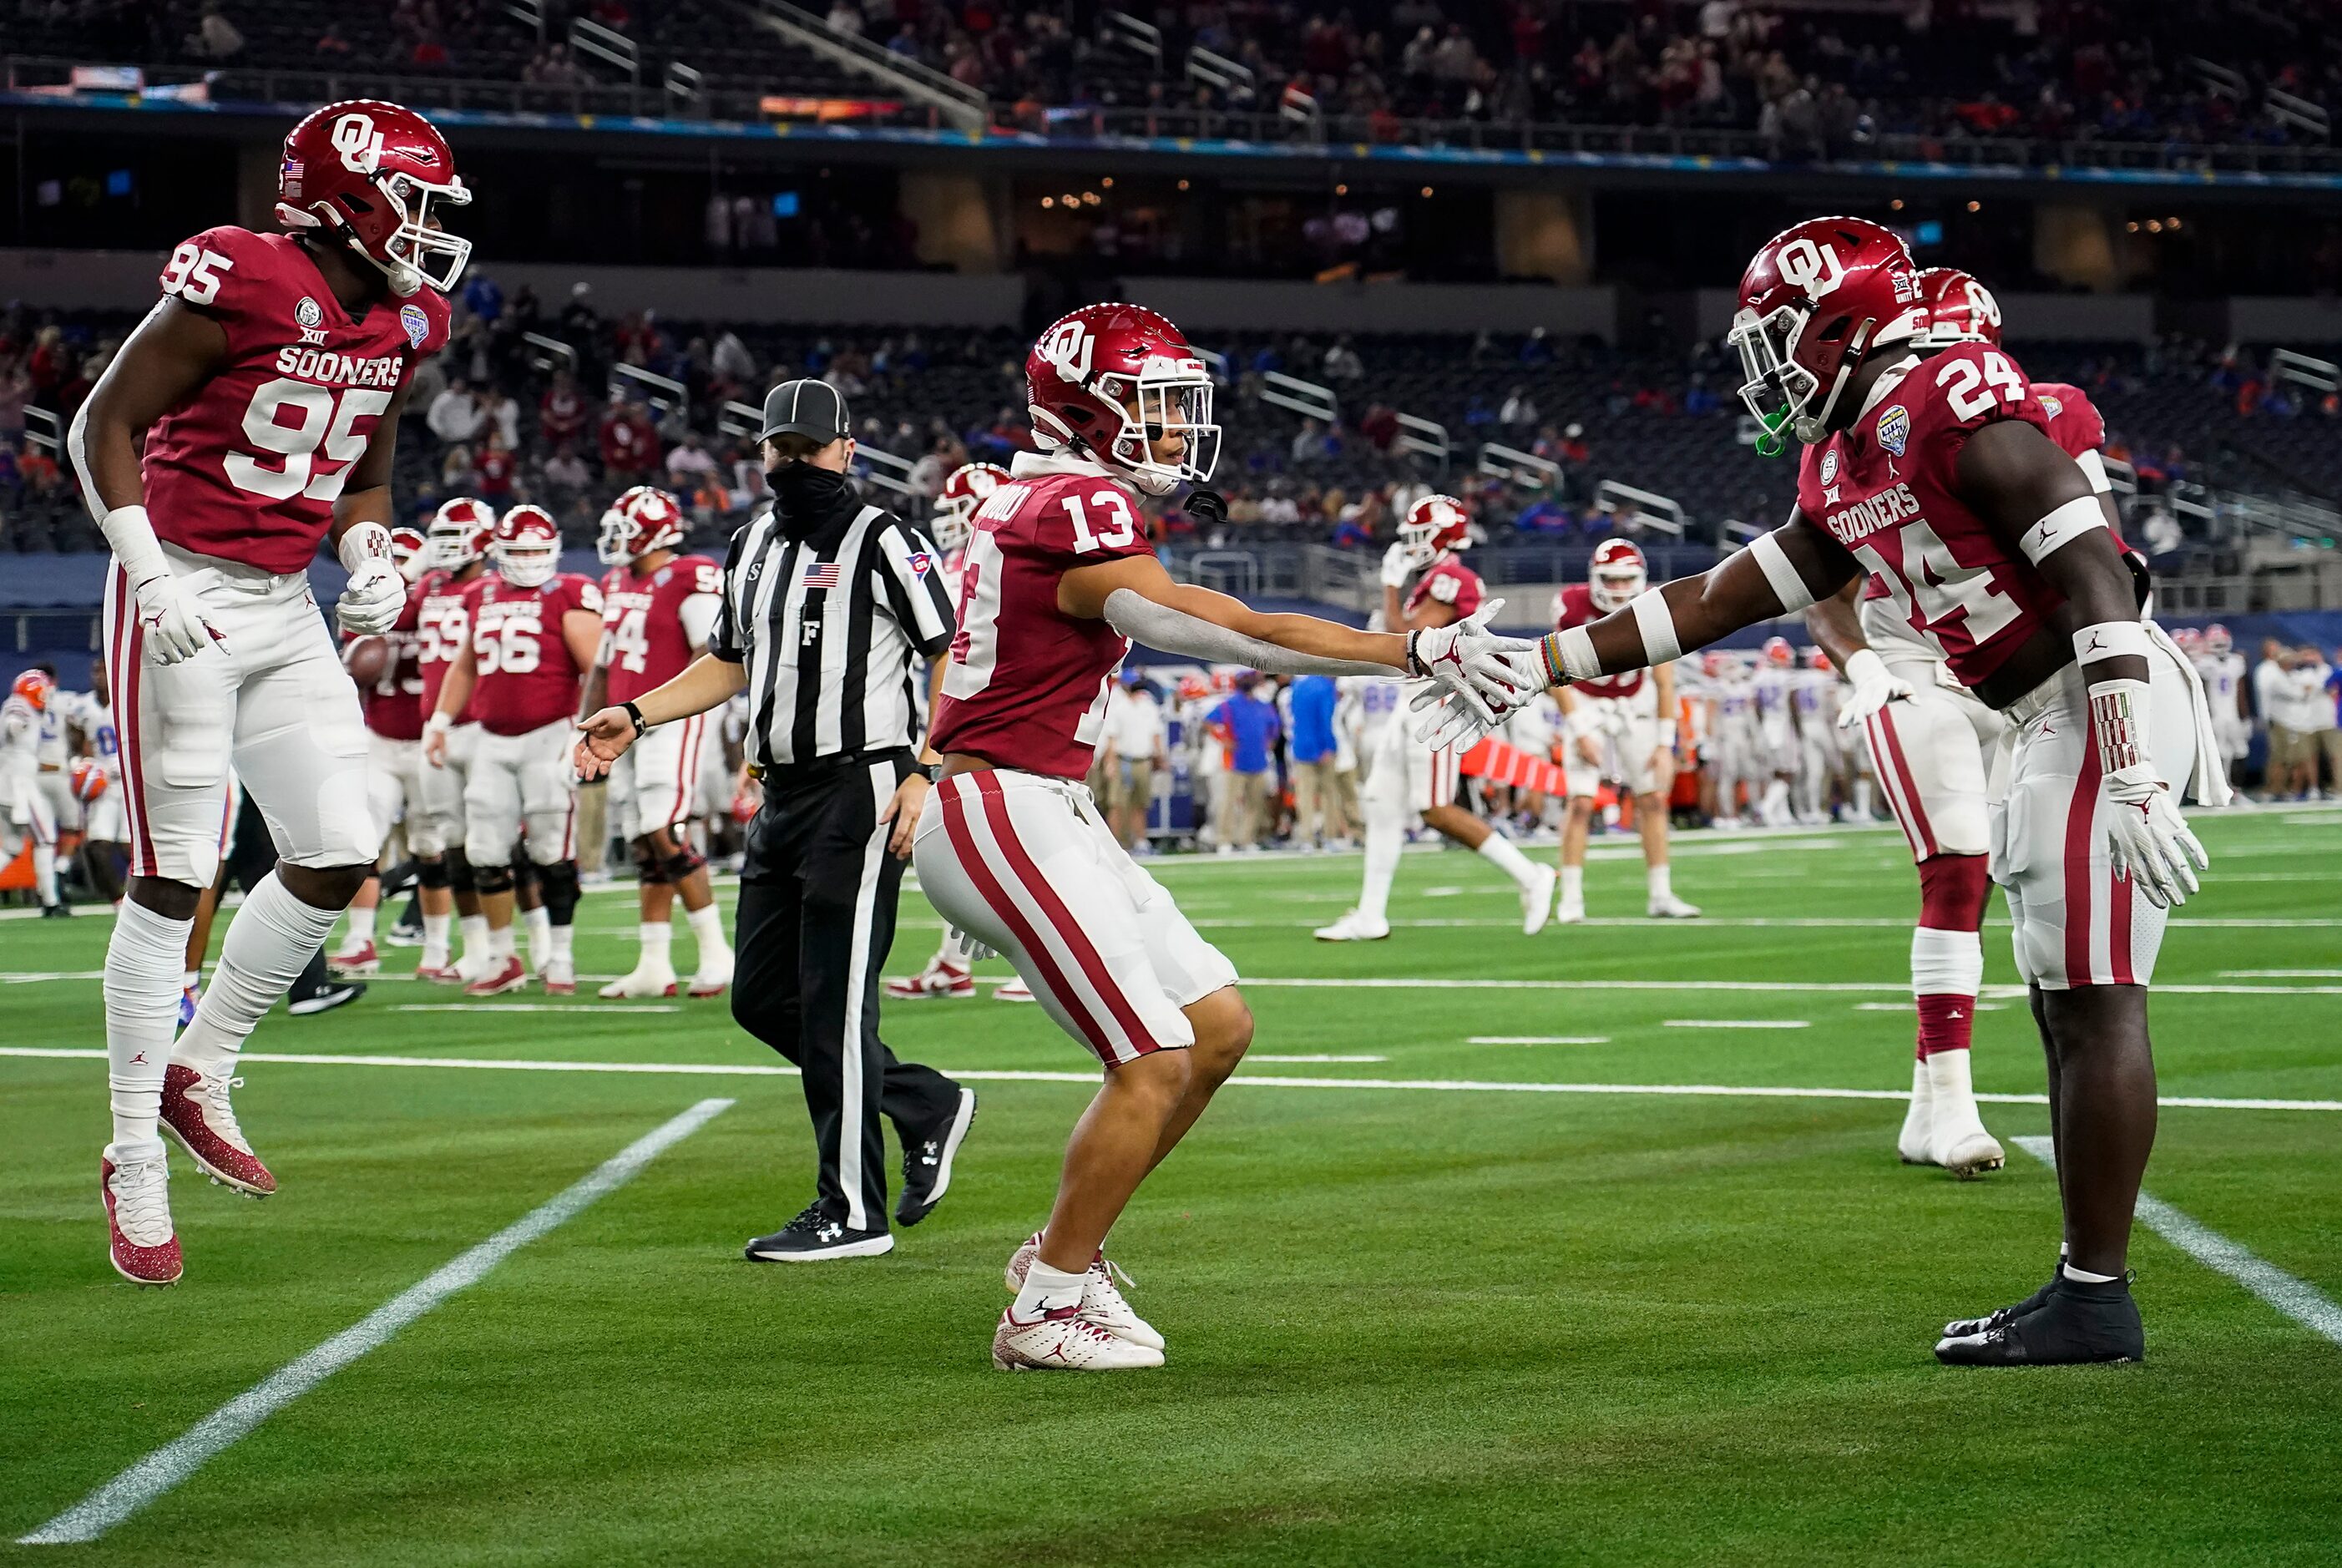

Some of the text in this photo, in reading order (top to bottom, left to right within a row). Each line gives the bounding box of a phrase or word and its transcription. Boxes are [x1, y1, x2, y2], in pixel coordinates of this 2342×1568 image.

[331, 114, 385, 174] OU
[159, 244, 234, 306] 95
[1775, 239, 1846, 297] OU
[276, 347, 402, 387] SOONERS
[1043, 321, 1095, 383] OU
[1935, 352, 2025, 422] 24
[223, 377, 393, 502] 95
[1061, 491, 1135, 554] 13
[1827, 482, 1920, 545] SOONERS
[474, 616, 544, 676] 56
[802, 620, 821, 646] F
